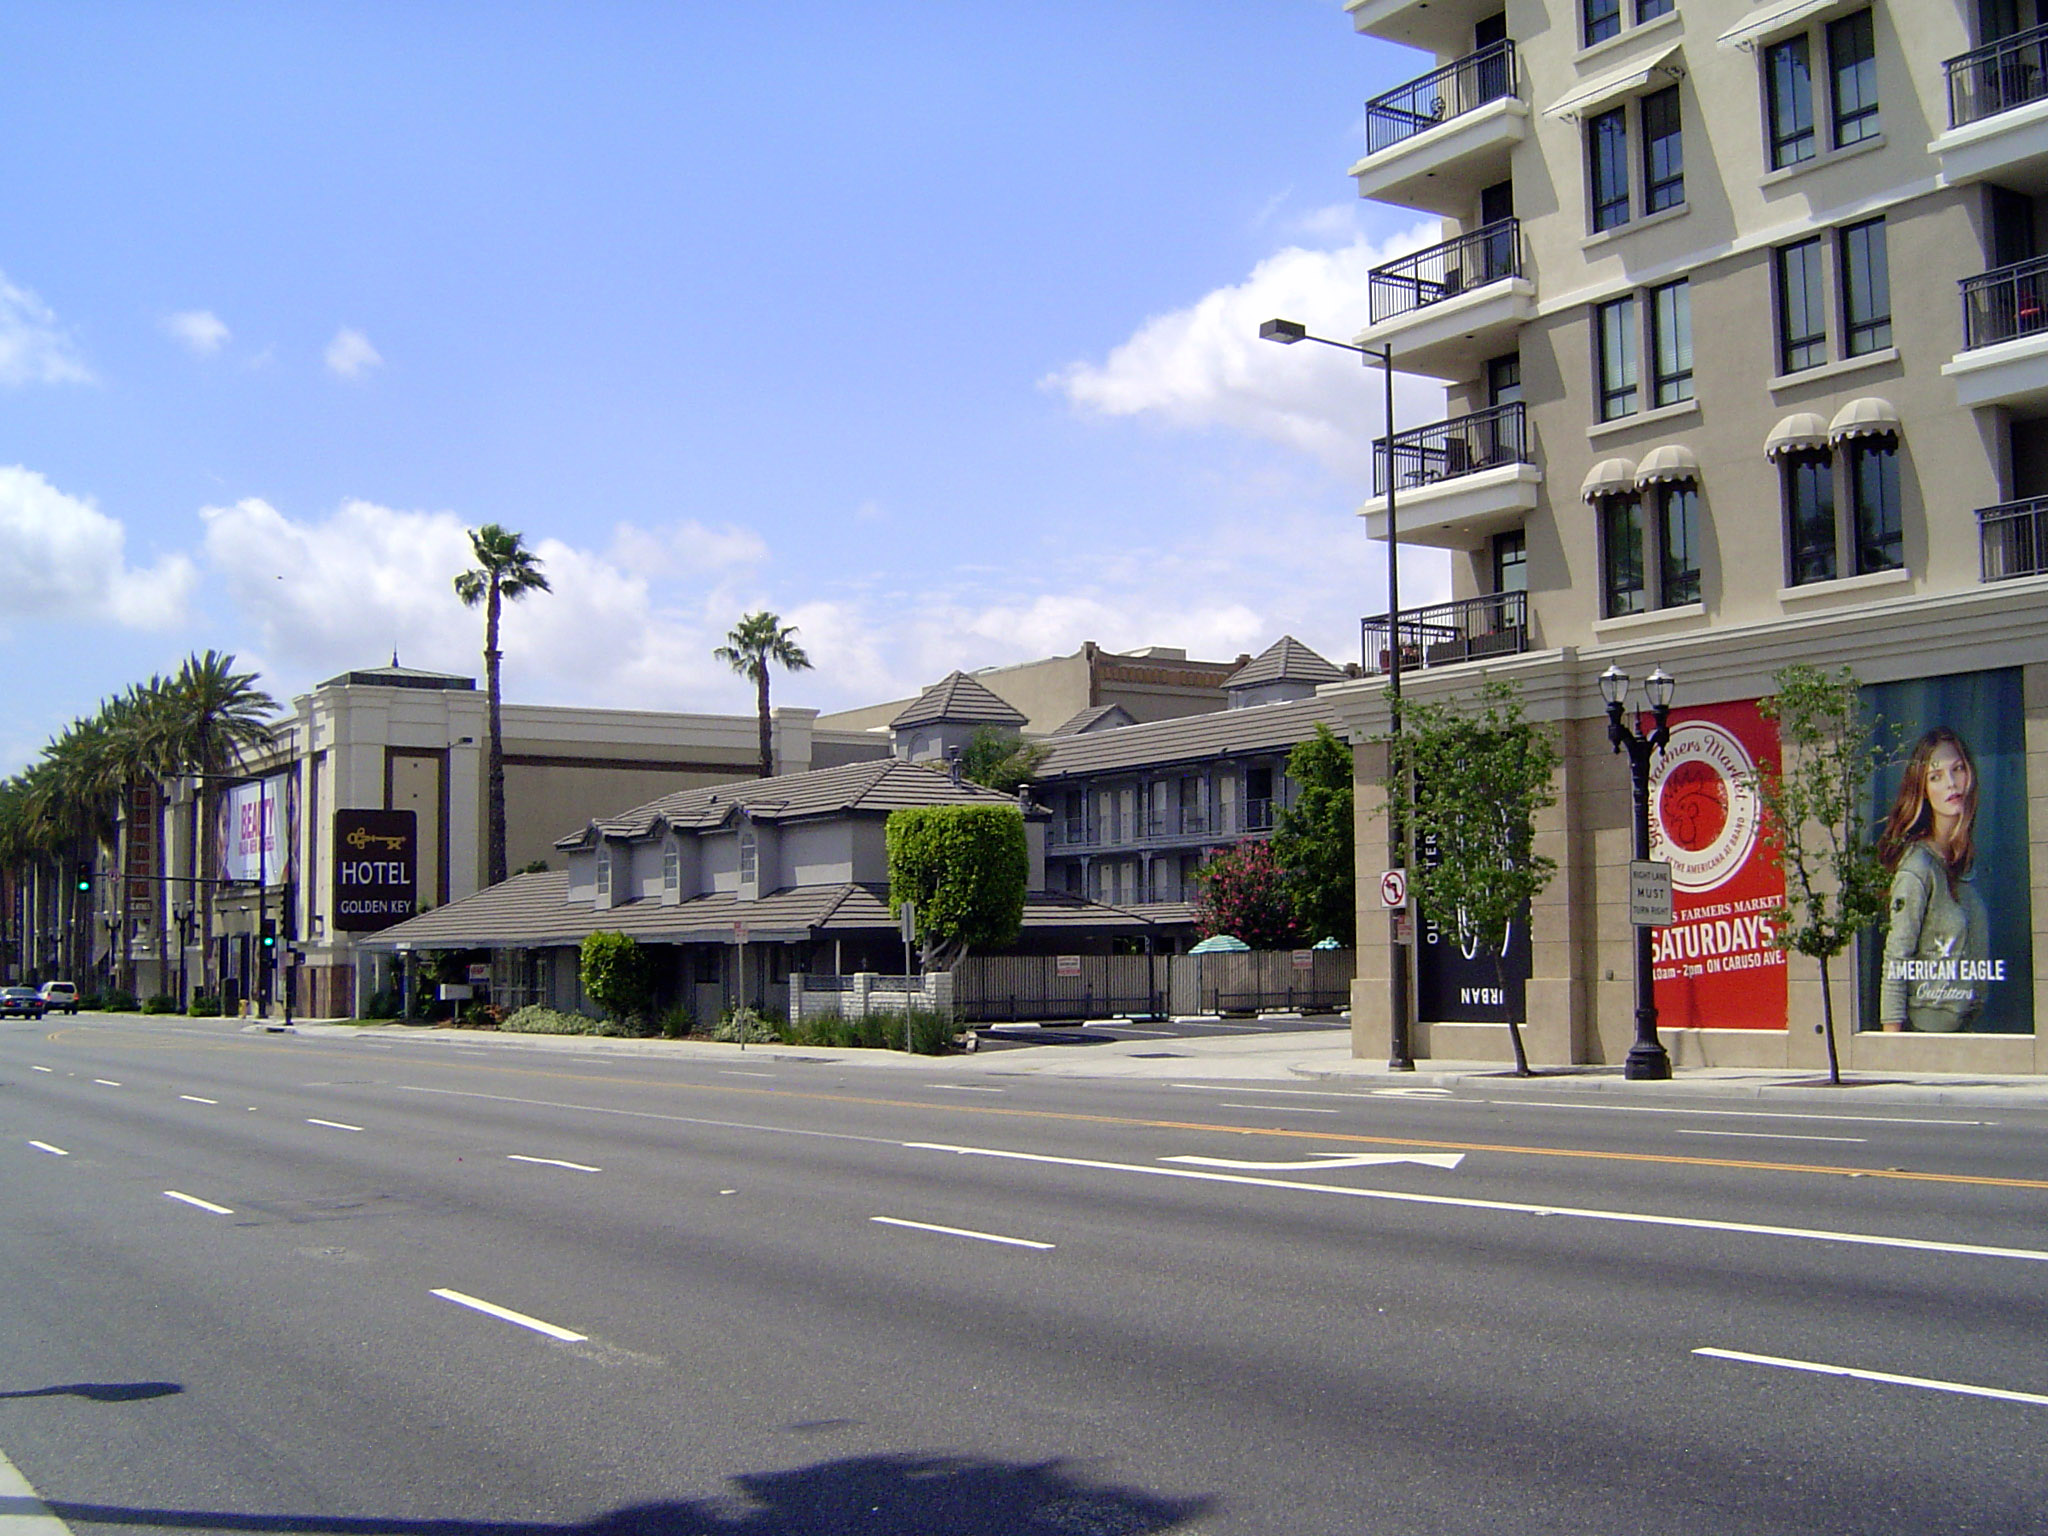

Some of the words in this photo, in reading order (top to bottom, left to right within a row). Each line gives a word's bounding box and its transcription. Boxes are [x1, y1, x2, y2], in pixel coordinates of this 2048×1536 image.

[1703, 734, 1748, 802] Market
[241, 797, 275, 840] BEATY
[1686, 853, 1725, 874] AMERICANA
[1732, 816, 1745, 848] BRAND
[342, 861, 411, 885] HOTEL
[1652, 871, 1667, 881] LANE
[1637, 887, 1664, 899] MUST
[341, 900, 388, 913] GOLDEN
[391, 900, 411, 913] KEY
[1633, 905, 1649, 914] TURN
[1650, 906, 1669, 916] RIGHT
[1681, 903, 1732, 921] FARMERS
[1733, 894, 1784, 913] MARKET
[1707, 958, 1720, 974] ON
[1722, 952, 1760, 972] CARUSO
[1763, 949, 1786, 967] AVE.
[1888, 960, 1956, 980] AMERICAN
[1960, 960, 2005, 980] EAGLE
[1917, 982, 1973, 1004] Outfitters
